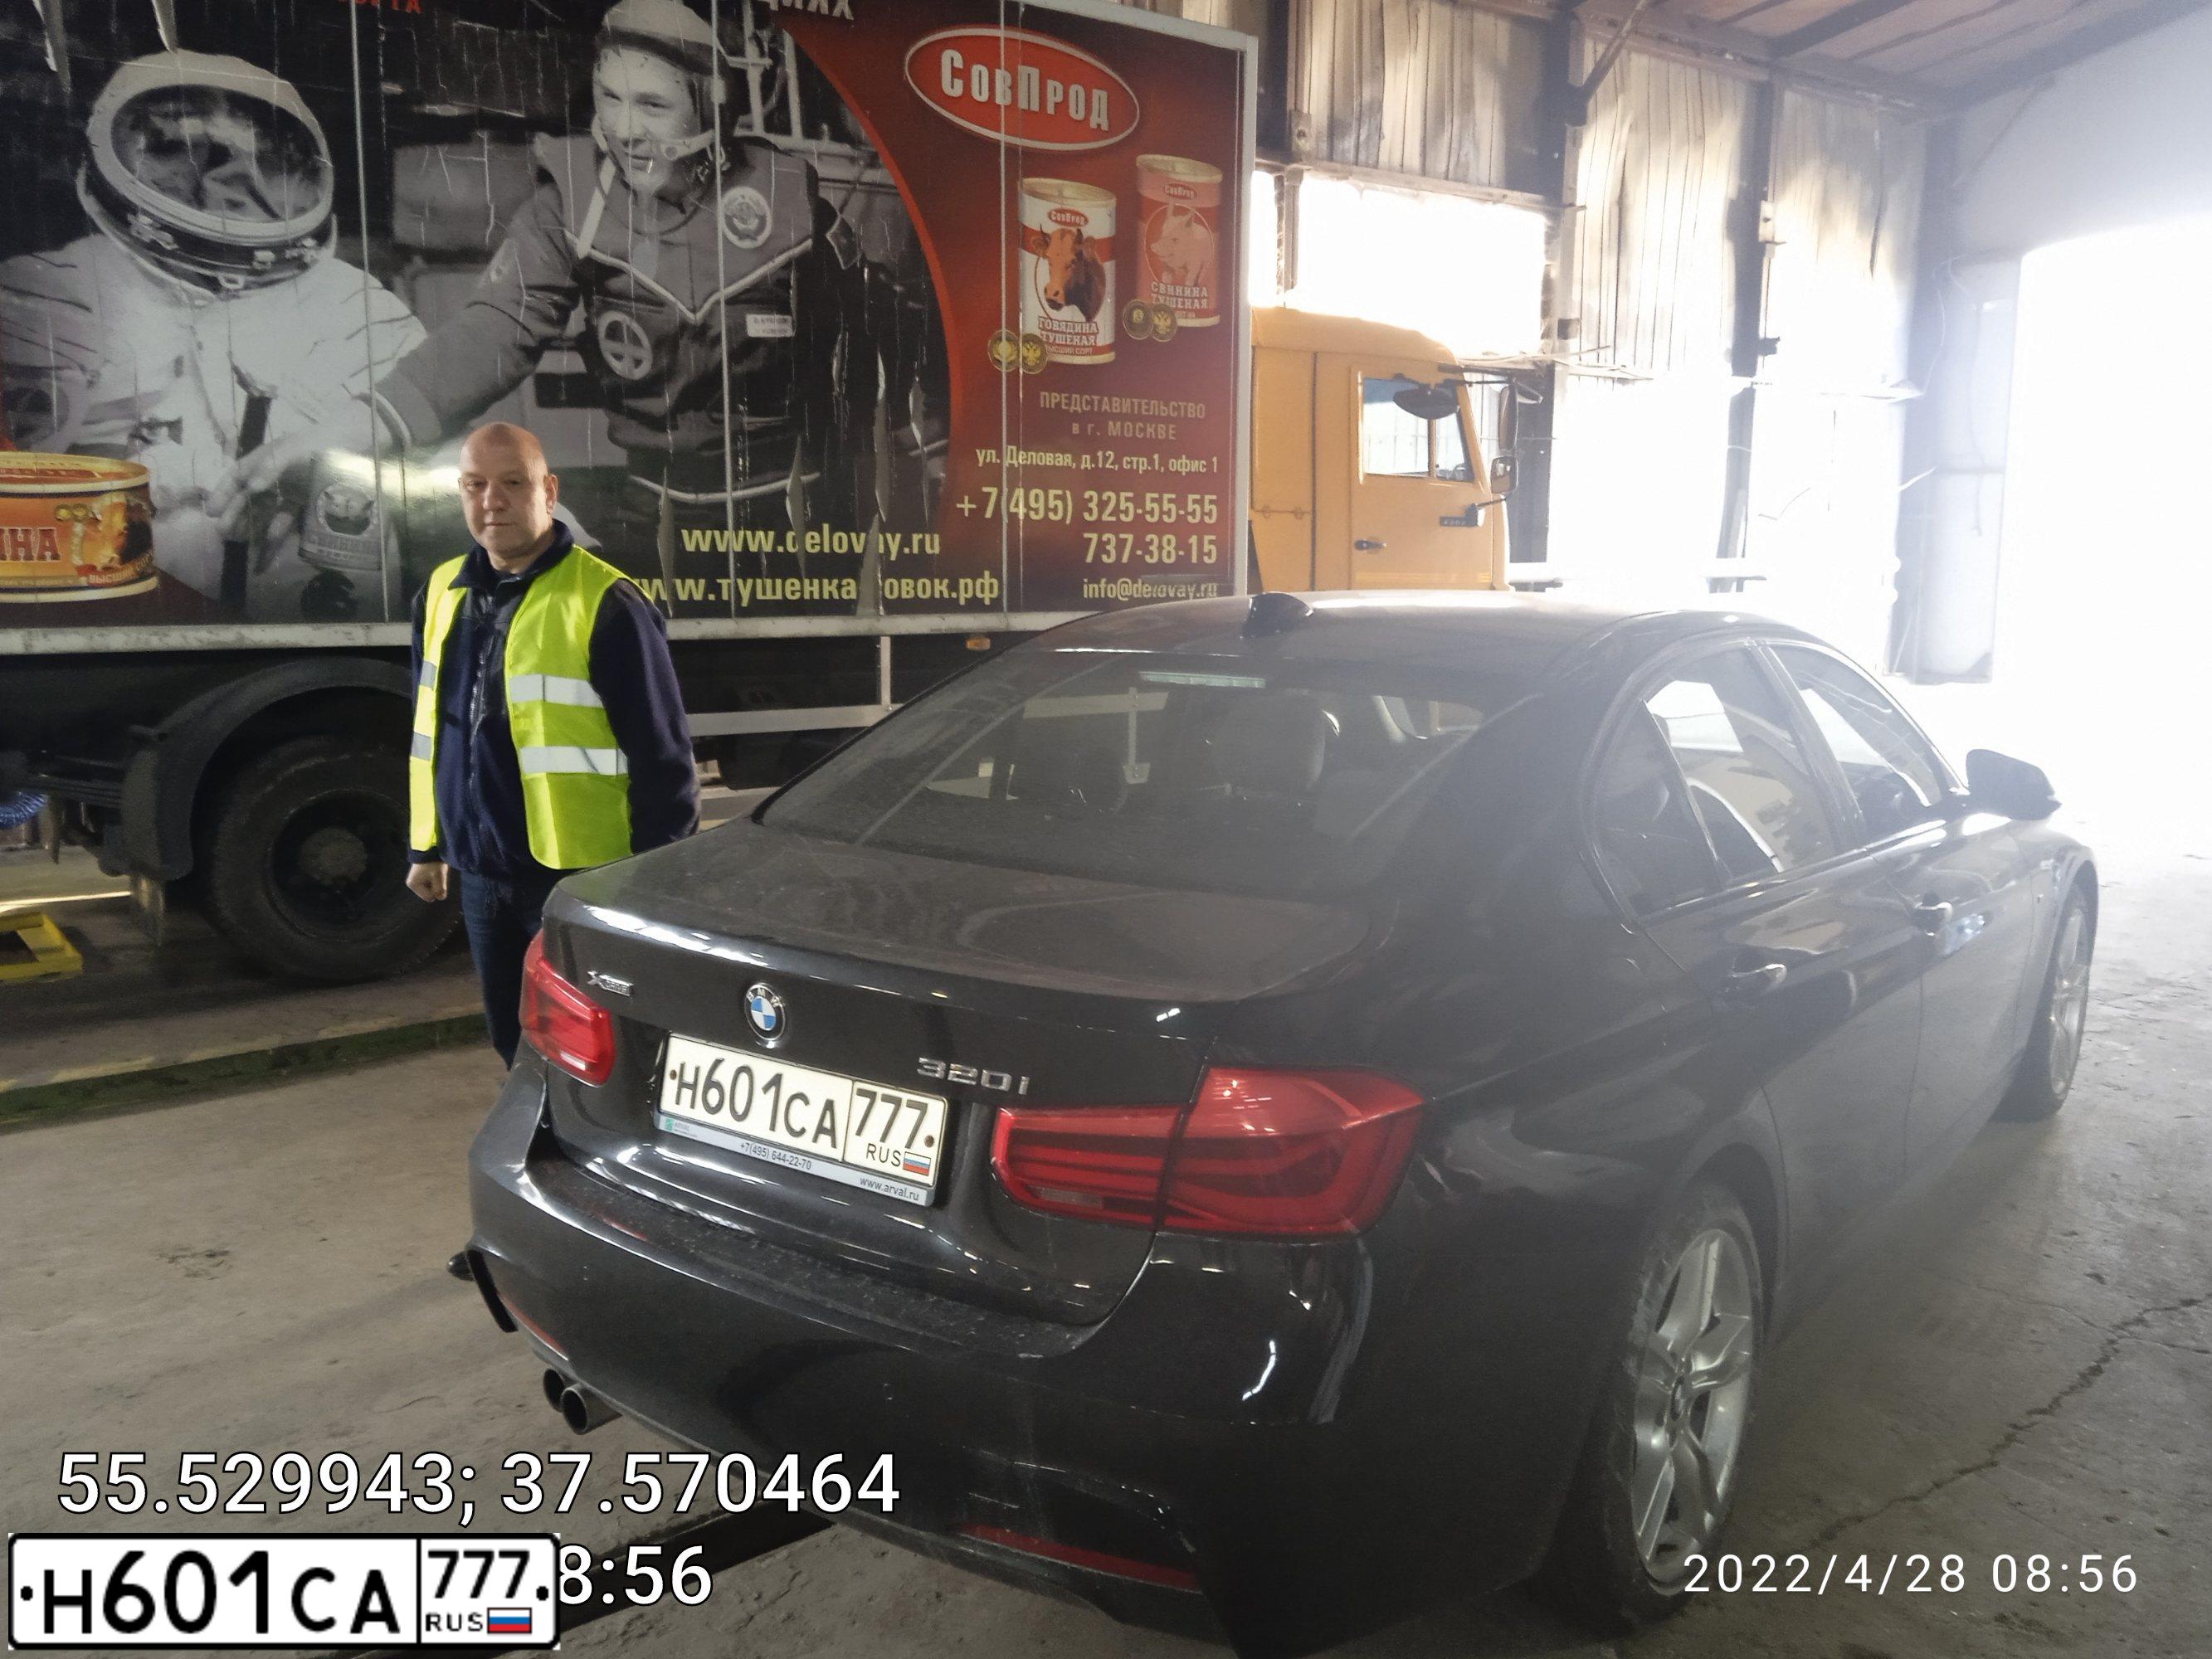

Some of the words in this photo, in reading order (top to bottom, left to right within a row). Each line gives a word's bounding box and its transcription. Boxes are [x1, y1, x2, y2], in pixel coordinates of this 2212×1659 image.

[940, 48, 1109, 132] СовПрод
[1040, 391, 1206, 419] ПРЕДСТАВИТЕЛЬСТВО
[1107, 421, 1177, 440] МОСКВЕ
[976, 448, 1000, 467] ул.
[1005, 445, 1077, 469] Деловая,
[1080, 450, 1118, 471] д.12,
[1123, 452, 1164, 474] стр.1,
[1168, 455, 1206, 475] офис
[1212, 456, 1218, 473] 1
[1083, 489, 1218, 524] 325-55-55
[681, 523, 940, 561] www.elovy.ru
[1083, 533, 1218, 565] 737-38-15
[632, 571, 999, 607] ww.тушенкаовок.рф
[917, 1057, 1030, 1095] 320i
[855, 1087, 928, 1151] 777
[865, 1142, 902, 1168] RUS
[859, 1175, 920, 1202] www.arval.ru
